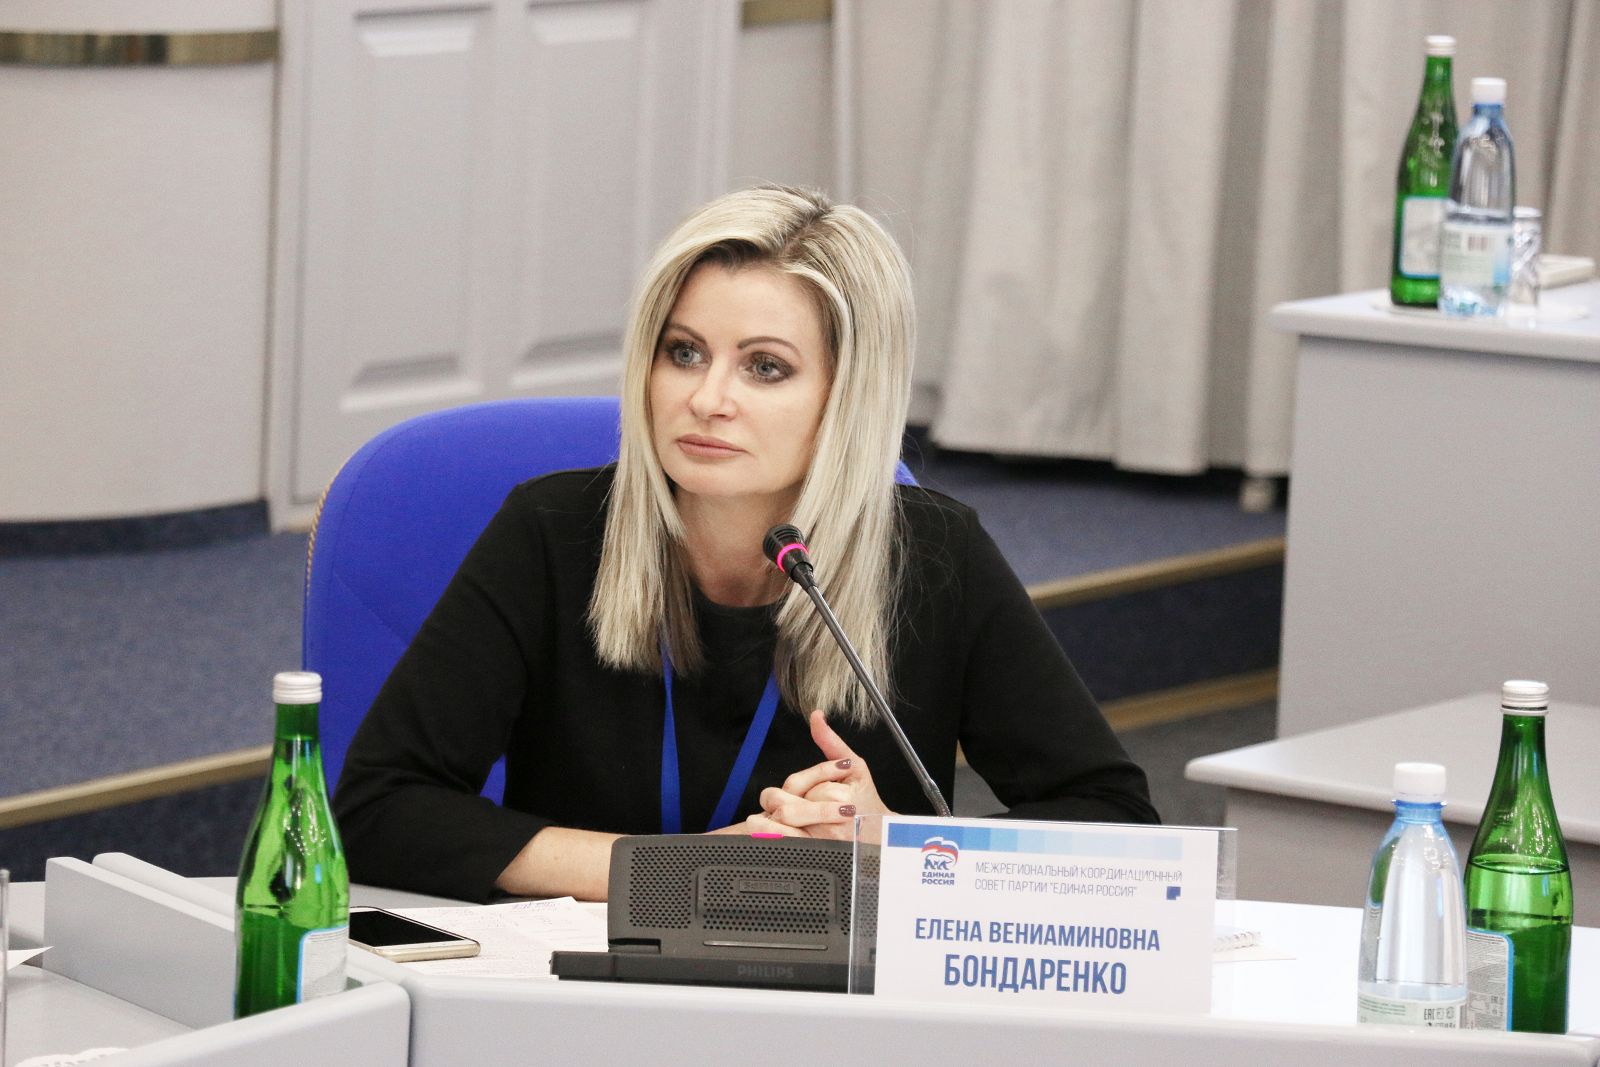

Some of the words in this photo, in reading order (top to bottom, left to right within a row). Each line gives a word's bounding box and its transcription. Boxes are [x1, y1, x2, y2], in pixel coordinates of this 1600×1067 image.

[922, 871, 955, 879] ЕДИНАЯ
[975, 862, 1079, 879] МЕЖРЕГИОНАЛЬНЫЙ
[1080, 866, 1183, 882] КООРДИНАЦИОННЫЙ
[975, 879, 1006, 892] СОВЕТ
[1008, 880, 1048, 893] ПАРТИИ
[915, 918, 983, 942] ЕЛЕНА
[989, 921, 1161, 951] ВЕНИАМИНОВНА
[737, 964, 794, 978] PHILIPS
[944, 953, 1127, 995] БОНДАРЕНКО
